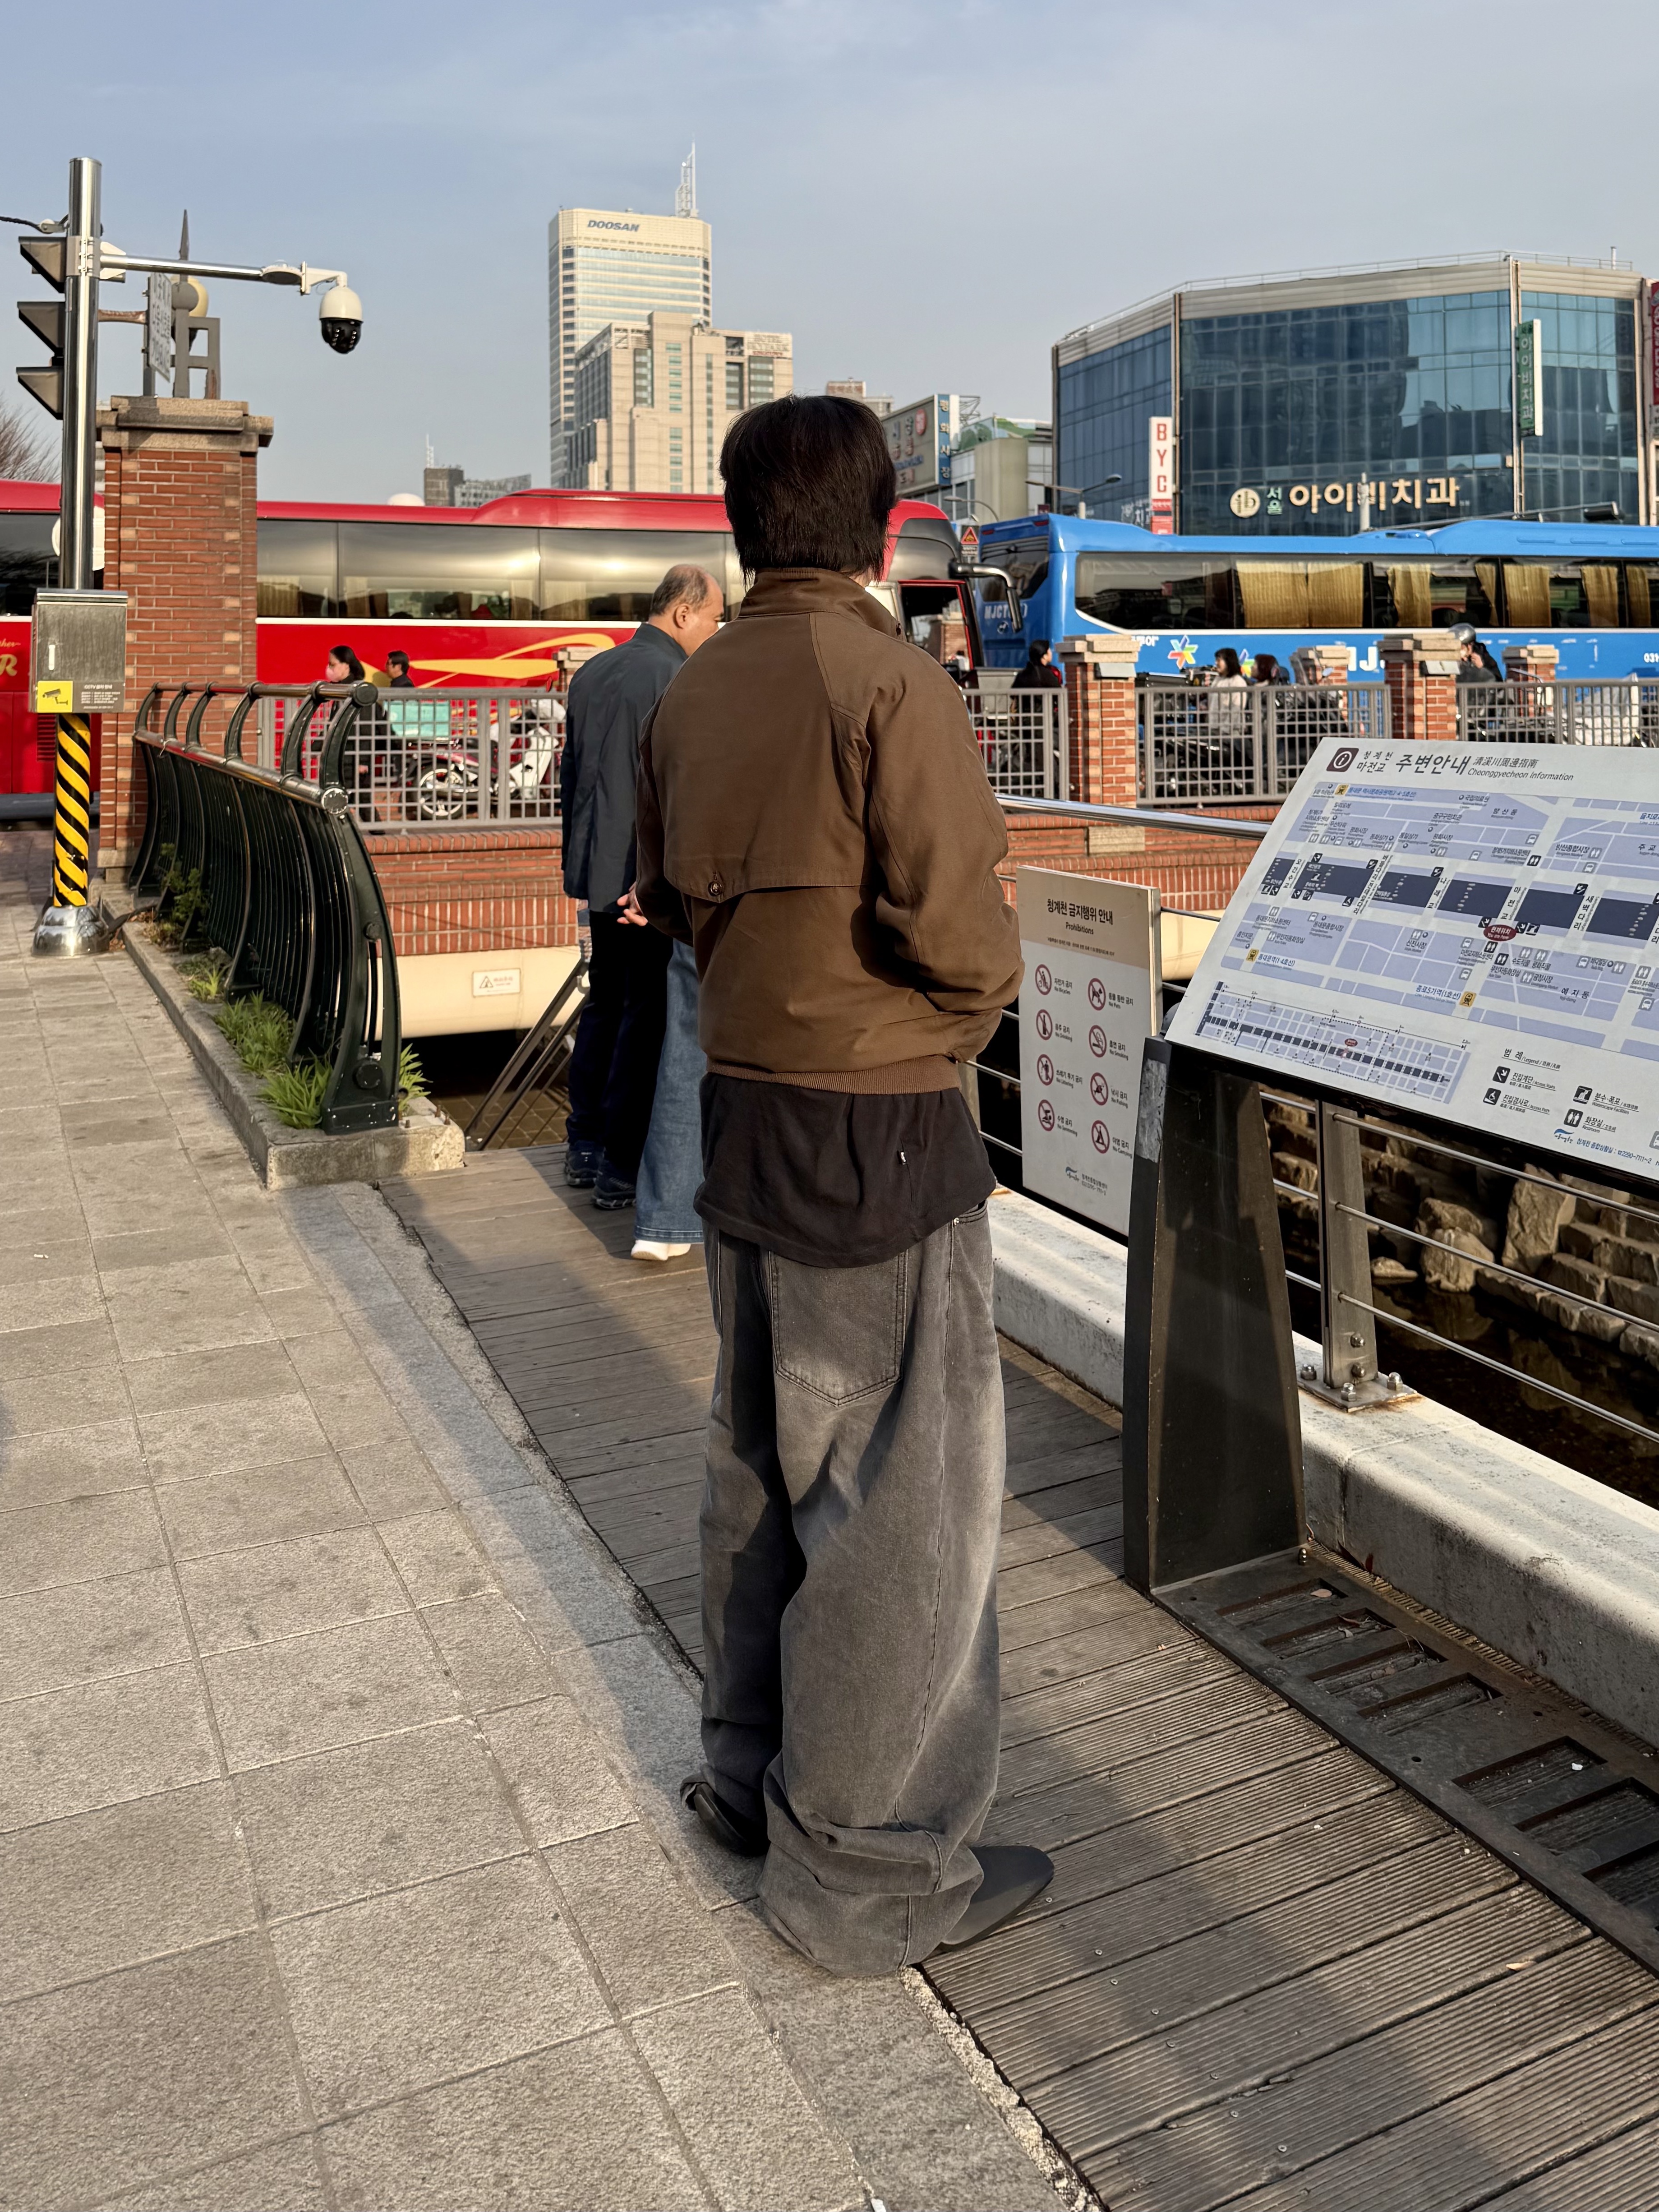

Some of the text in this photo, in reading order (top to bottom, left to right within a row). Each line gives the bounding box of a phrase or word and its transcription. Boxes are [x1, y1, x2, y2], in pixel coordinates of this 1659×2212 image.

[588, 220, 640, 232] DOOSAN
[940, 399, 950, 479] 평화시장
[1157, 422, 1167, 493] BYC
[1357, 762, 1386, 773] 마전교
[1396, 754, 1470, 776] 주변안내
[1468, 768, 1574, 781] Cheonggyecheon Information
[1500, 887, 1521, 920] 마전교
[1047, 898, 1113, 925] 청계천 금지행위 안내
[1065, 921, 1094, 935] Prohibitions
[1490, 928, 1511, 937] 현재위치
[1054, 978, 1073, 989] 자전거 금지
[1108, 993, 1116, 1002] 동물
[1125, 997, 1134, 1006] 금지
[1055, 1023, 1070, 1034] 음주 금지
[1109, 1040, 1126, 1052] 흡연 금지
[1056, 1069, 1066, 1079] 쓰레기
[1075, 1075, 1083, 1085] 금지
[1512, 1072, 1534, 1084] 진입계단
[1111, 1088, 1128, 1101] 낚시 금지
[1592, 1101, 1613, 1112] Waterscape
[1613, 1107, 1630, 1115] Facilities
[1057, 1115, 1073, 1127] 수영 금지
[1585, 1116, 1604, 1128] 화장실
[1112, 1136, 1129, 1150] 야영 금지
